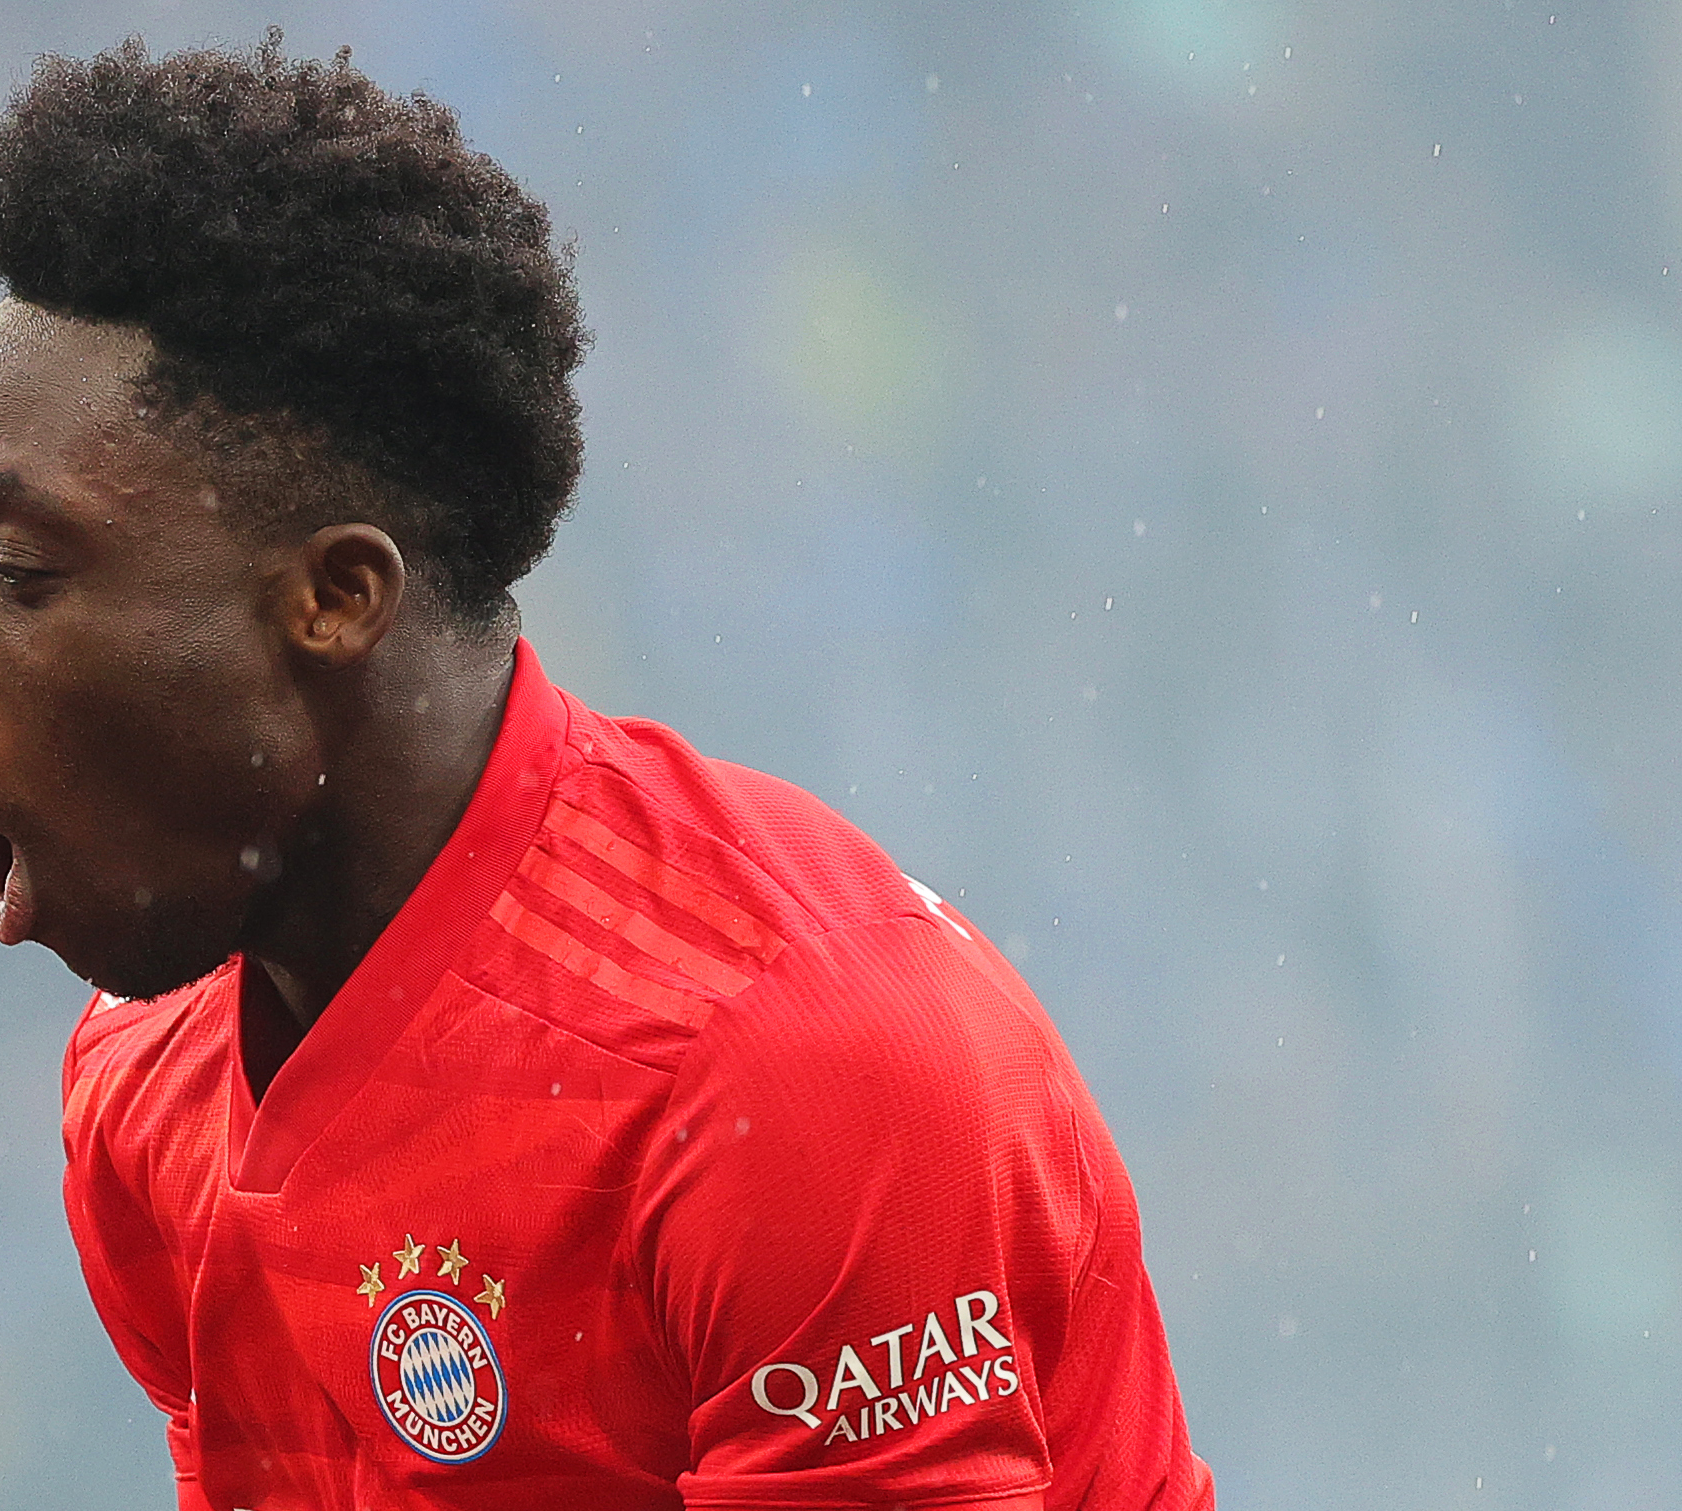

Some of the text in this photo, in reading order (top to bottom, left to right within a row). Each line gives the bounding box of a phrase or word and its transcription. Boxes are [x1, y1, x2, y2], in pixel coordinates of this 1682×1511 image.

[380, 1303, 488, 1370] FC BAYERN
[750, 1289, 1013, 1430] QATAR
[386, 1389, 495, 1452] MÜNCHEN
[823, 1354, 1020, 1446] AIRWAYS
